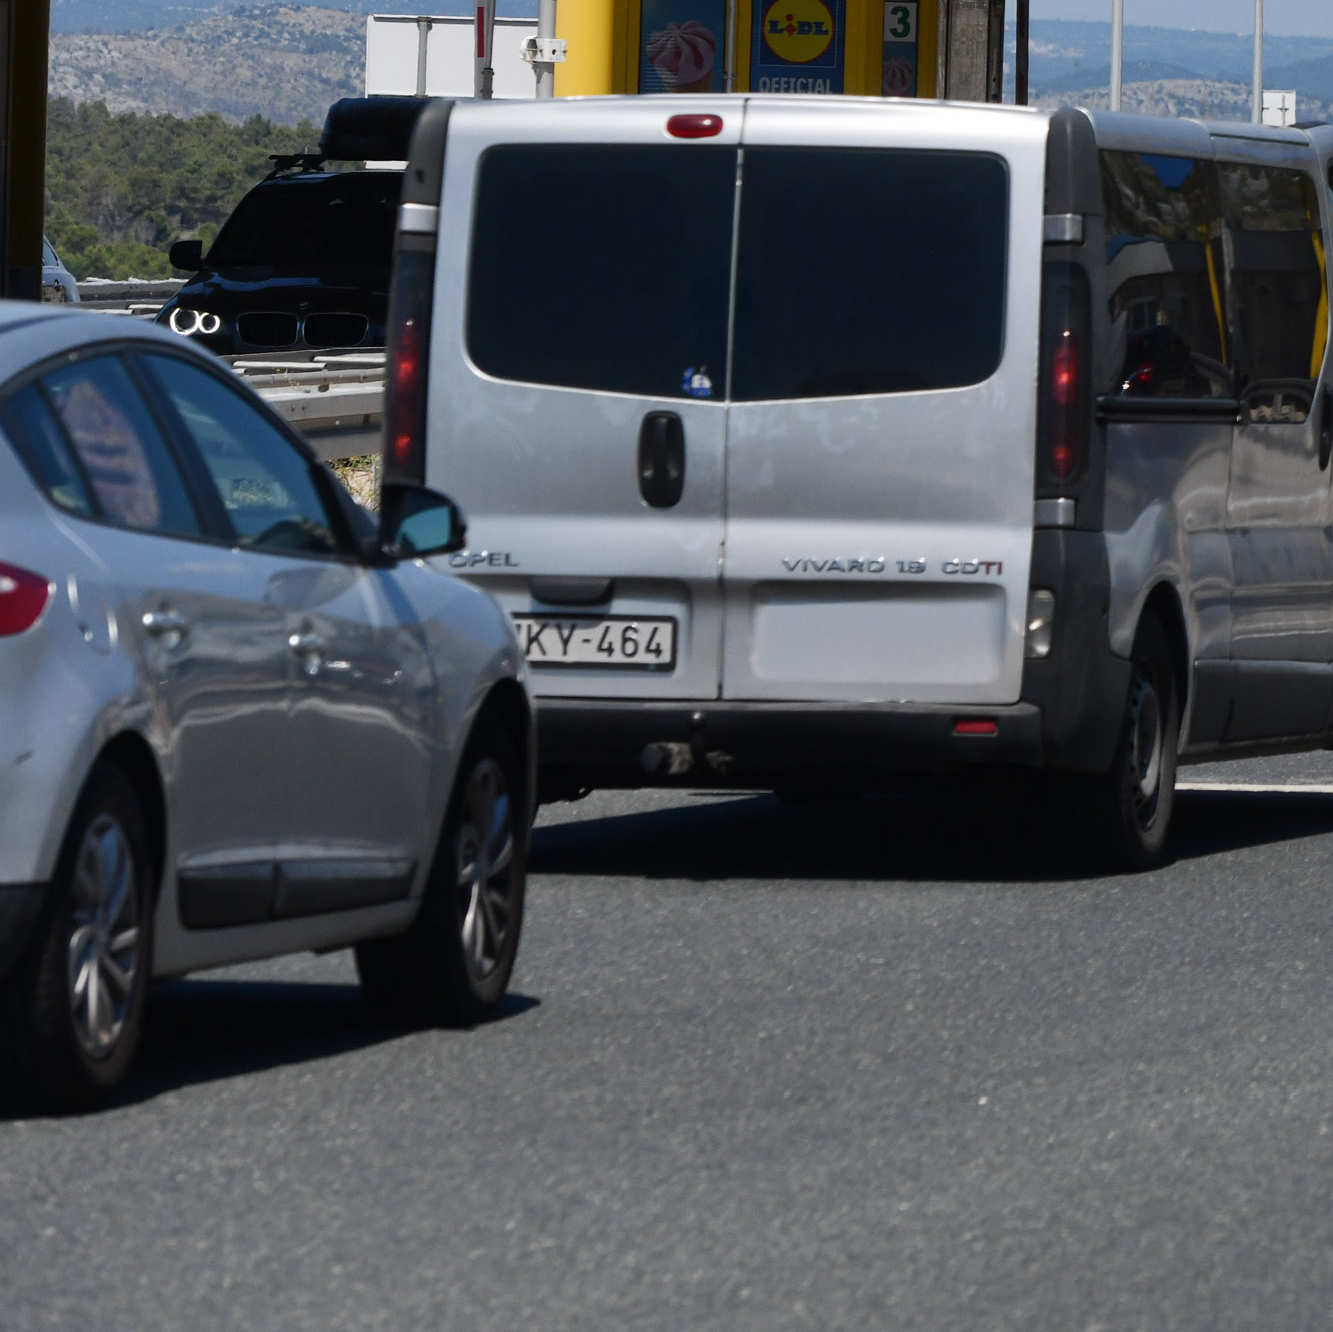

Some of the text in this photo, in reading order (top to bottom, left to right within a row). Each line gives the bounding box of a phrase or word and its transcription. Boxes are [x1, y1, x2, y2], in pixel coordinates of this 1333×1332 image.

[768, 14, 829, 37] LIDL
[889, 6, 911, 38] 3
[759, 77, 833, 94] OFFICIAL
[448, 552, 519, 568] OPEL
[782, 558, 886, 573] VIVARO
[941, 559, 1003, 576] CDTI
[516, 623, 663, 658] KY-464
